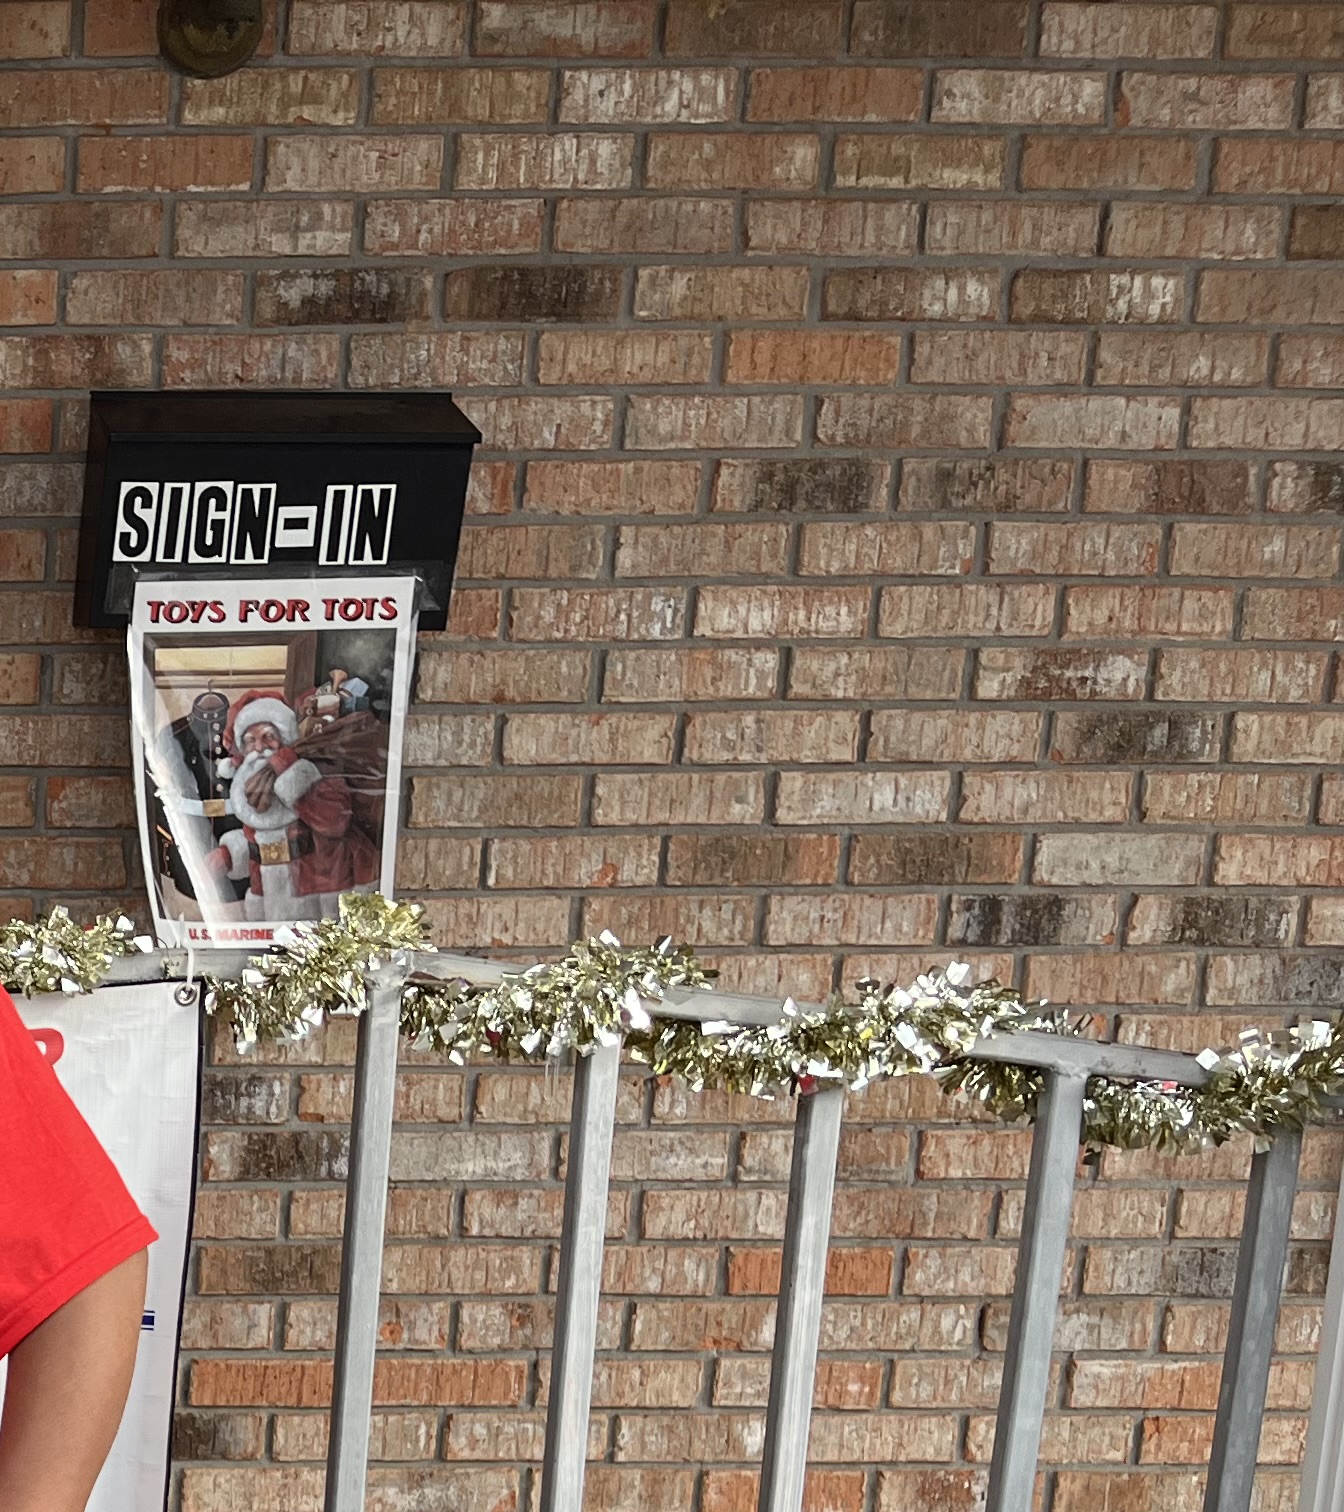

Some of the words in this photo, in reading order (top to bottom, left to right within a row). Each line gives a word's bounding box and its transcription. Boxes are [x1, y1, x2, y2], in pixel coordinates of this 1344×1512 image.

[114, 482, 395, 563] SIGN-IN
[147, 599, 226, 624] TOYS
[238, 599, 311, 623] FOR
[321, 597, 398, 621] TOTS
[216, 928, 275, 941] MARINE
